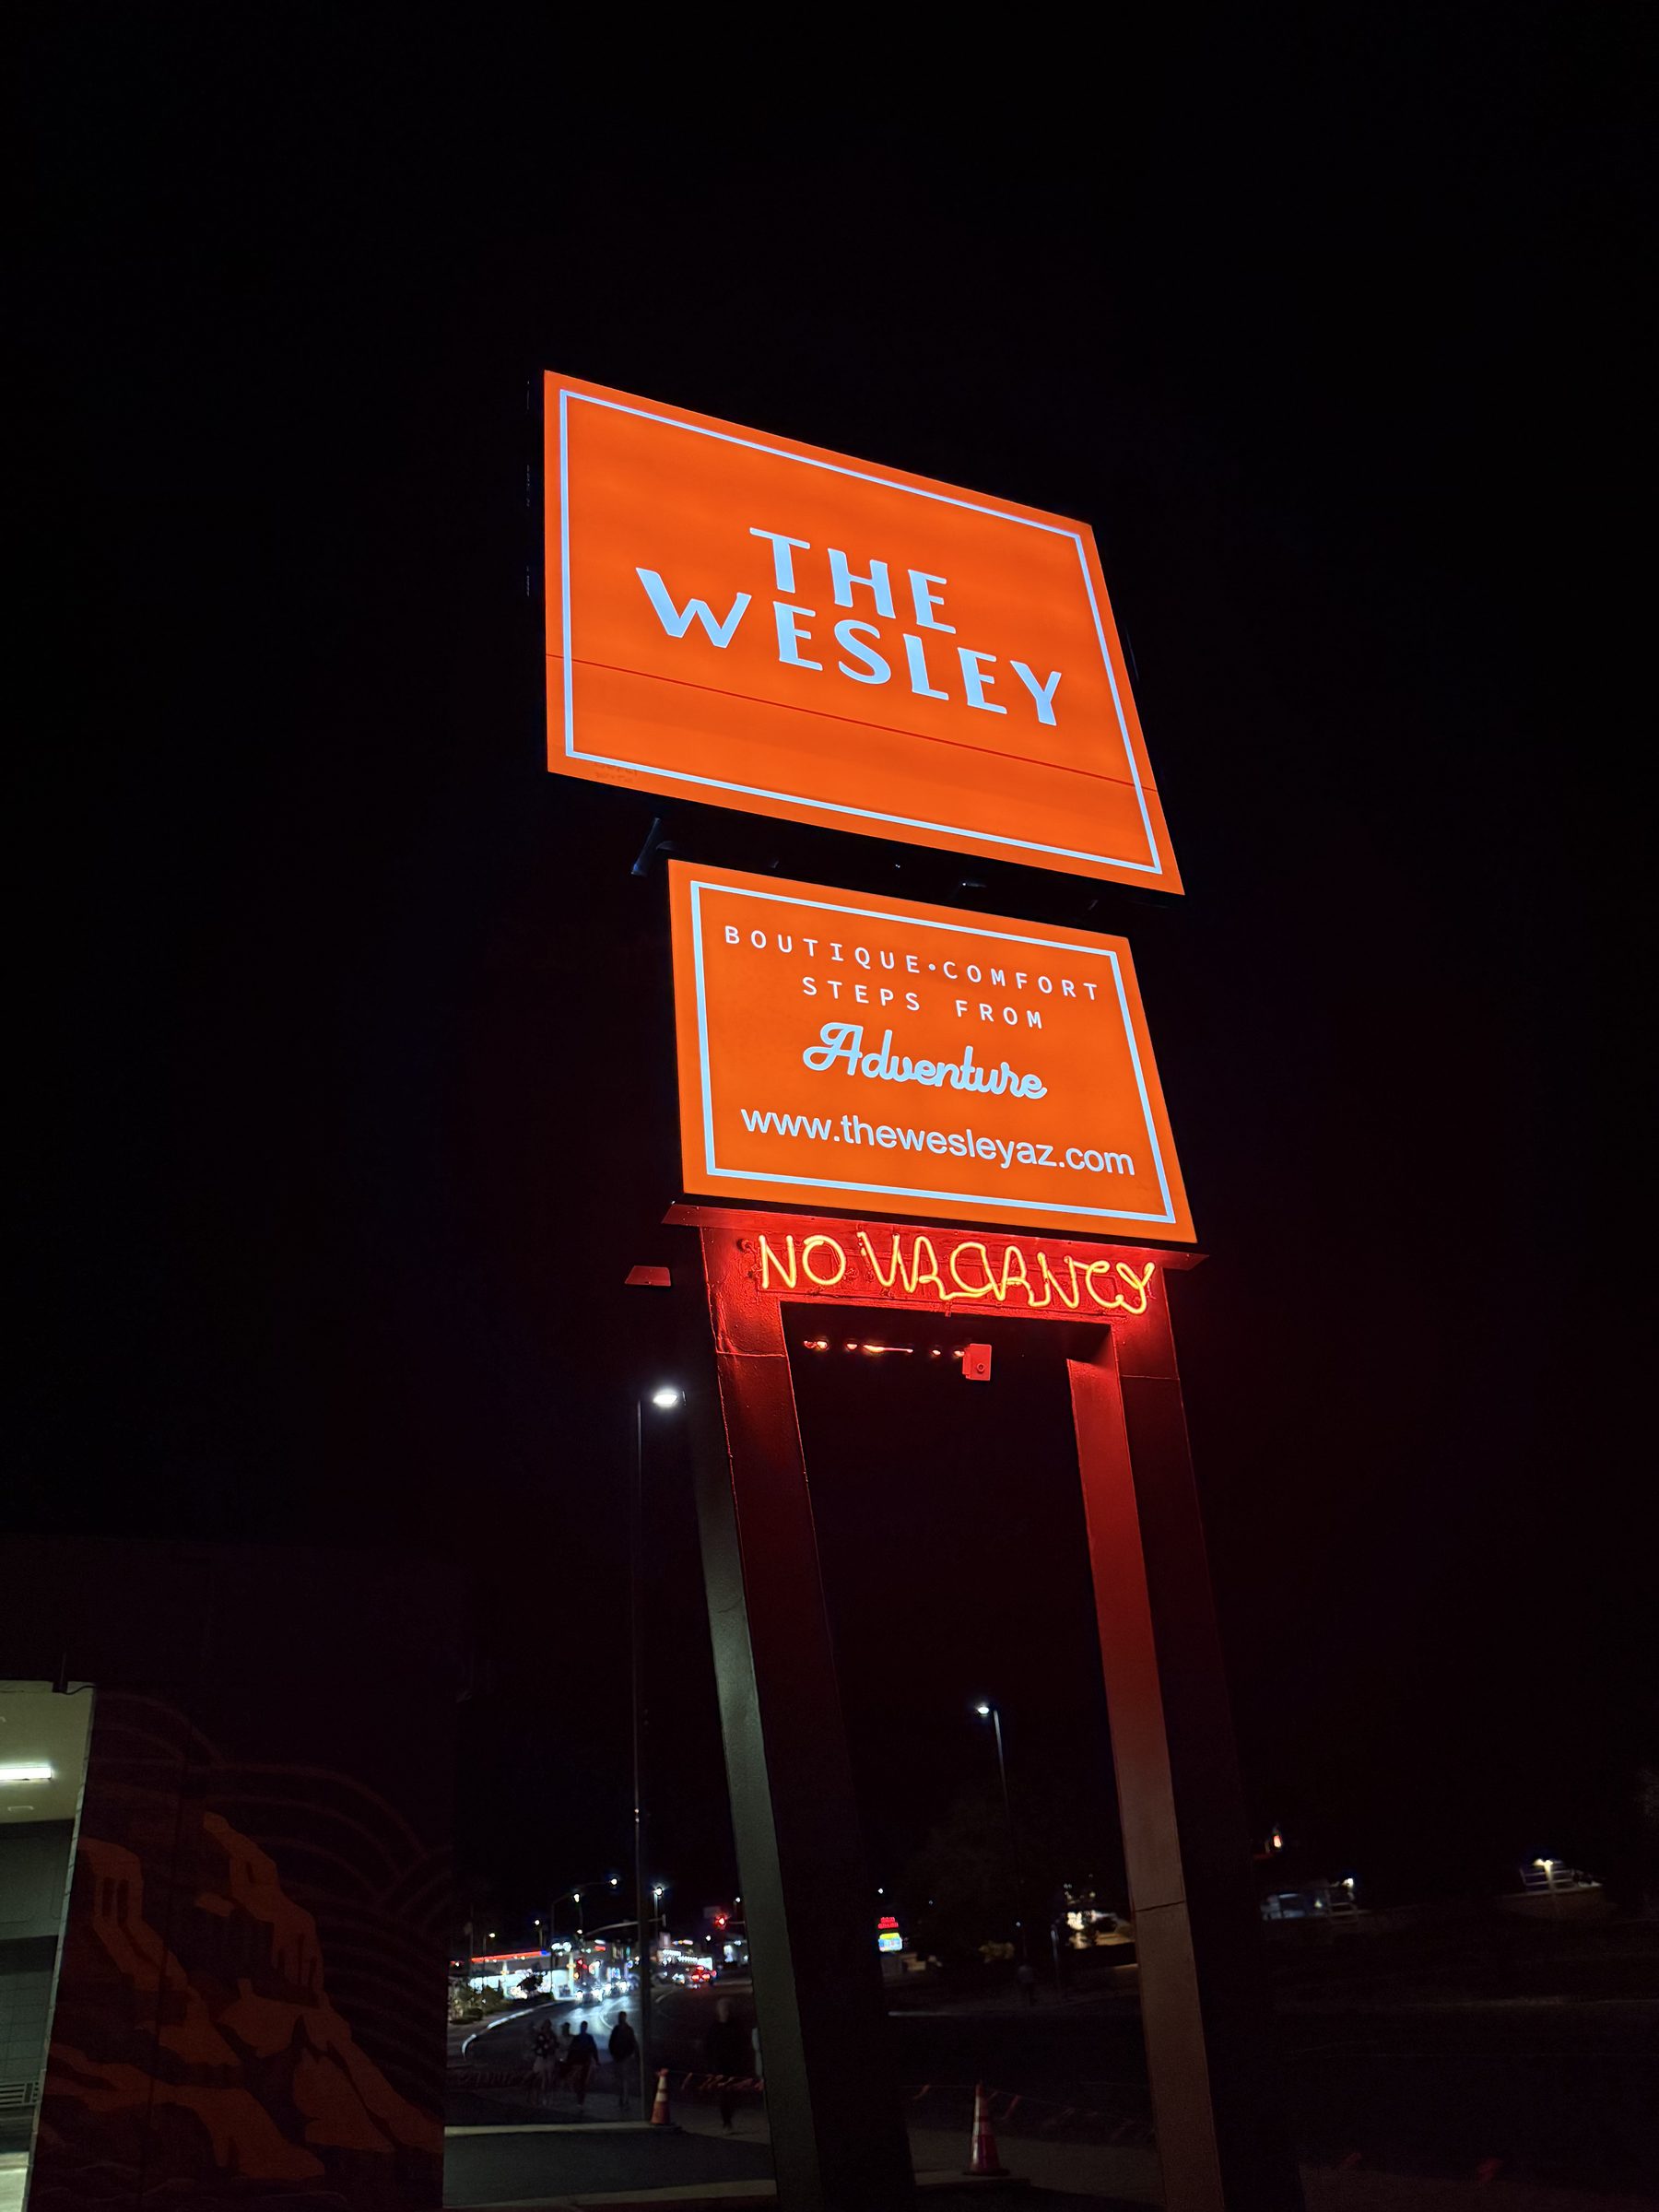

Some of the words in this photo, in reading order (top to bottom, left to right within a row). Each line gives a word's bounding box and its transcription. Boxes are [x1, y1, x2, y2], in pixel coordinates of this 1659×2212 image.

[749, 527, 957, 634] THE
[636, 568, 1062, 726] WESLEY
[803, 977, 920, 1011] STEPS
[955, 1000, 1042, 1030] FROM
[803, 1022, 1048, 1100] Adventure
[741, 1108, 1135, 1176] www.thewesleyaz.com
[758, 1234, 847, 1288] NO
[857, 1231, 1156, 1315] VACANCY
